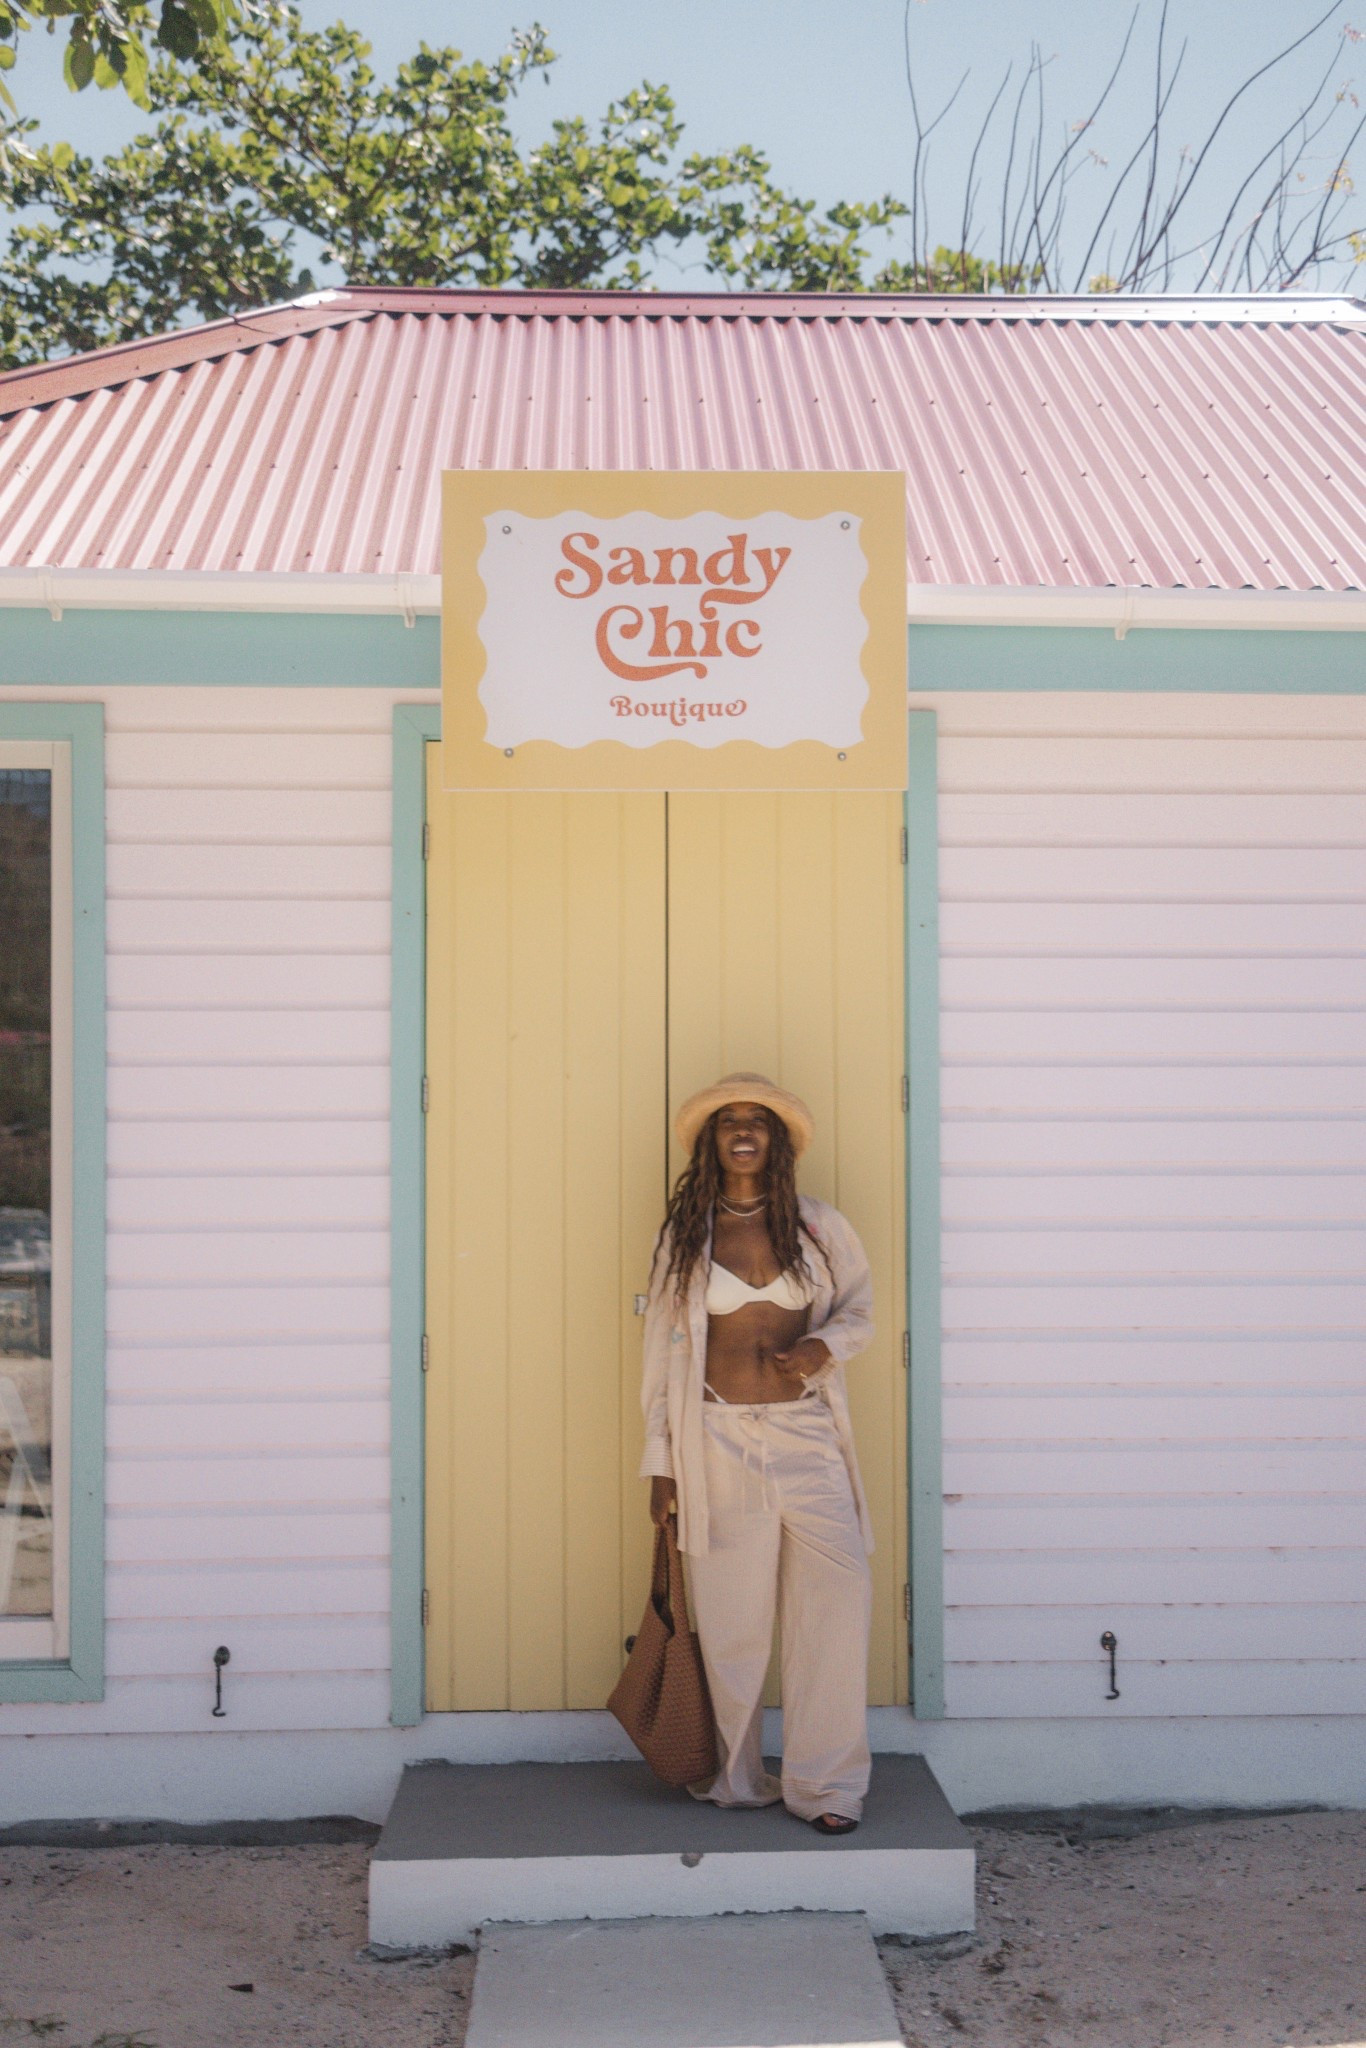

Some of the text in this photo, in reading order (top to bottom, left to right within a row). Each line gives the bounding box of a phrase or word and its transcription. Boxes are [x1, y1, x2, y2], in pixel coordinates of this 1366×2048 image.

[554, 532, 792, 619] Sandy
[595, 605, 763, 681] Chic
[609, 695, 747, 727] Boutique
